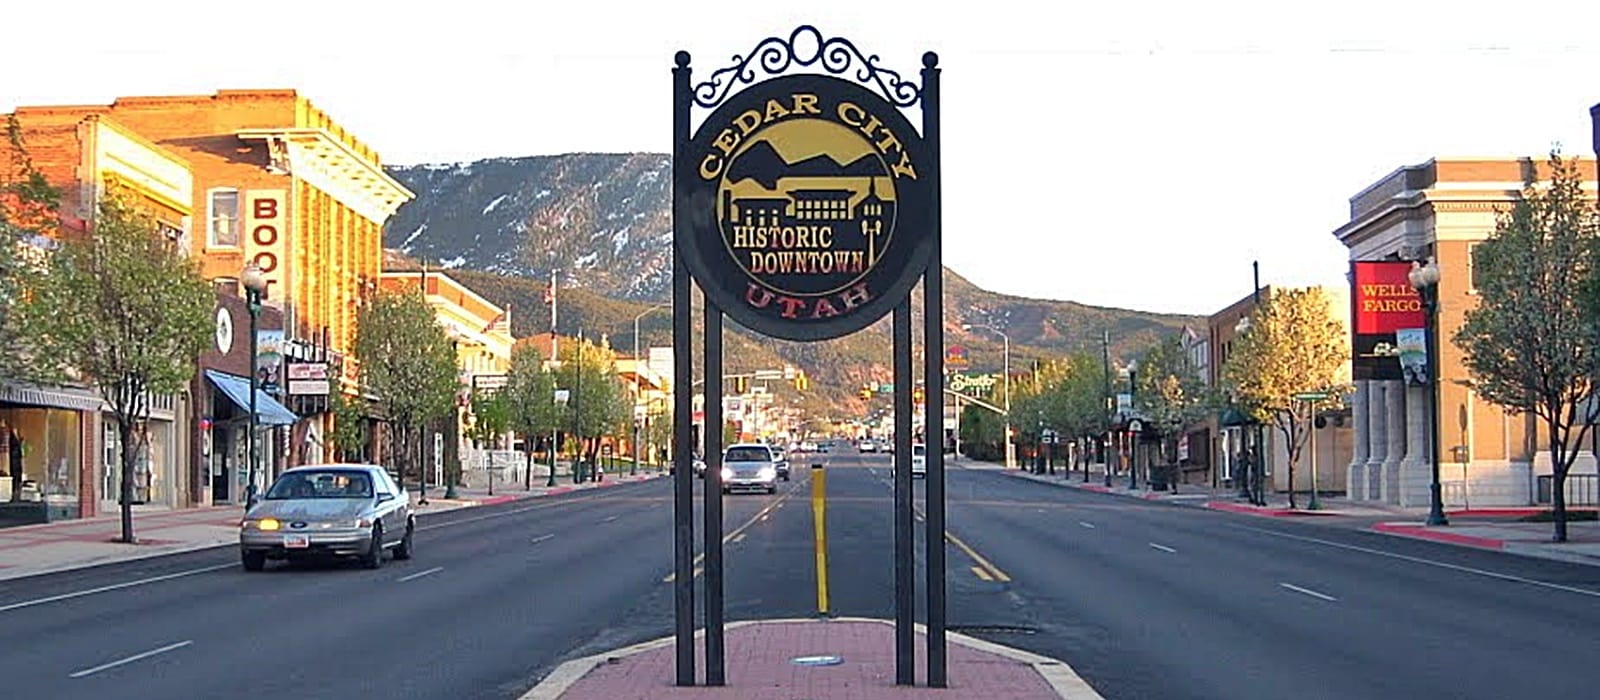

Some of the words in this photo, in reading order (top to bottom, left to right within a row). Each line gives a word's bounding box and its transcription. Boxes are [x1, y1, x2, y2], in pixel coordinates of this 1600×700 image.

[699, 94, 821, 179] CEDAR
[837, 102, 917, 180] CITY
[733, 226, 832, 248] HISTORIC
[750, 251, 864, 273] DOWNTOWN
[746, 282, 872, 318] UTAH
[1361, 284, 1420, 297] WELLS
[1363, 300, 1421, 312] FARGO
